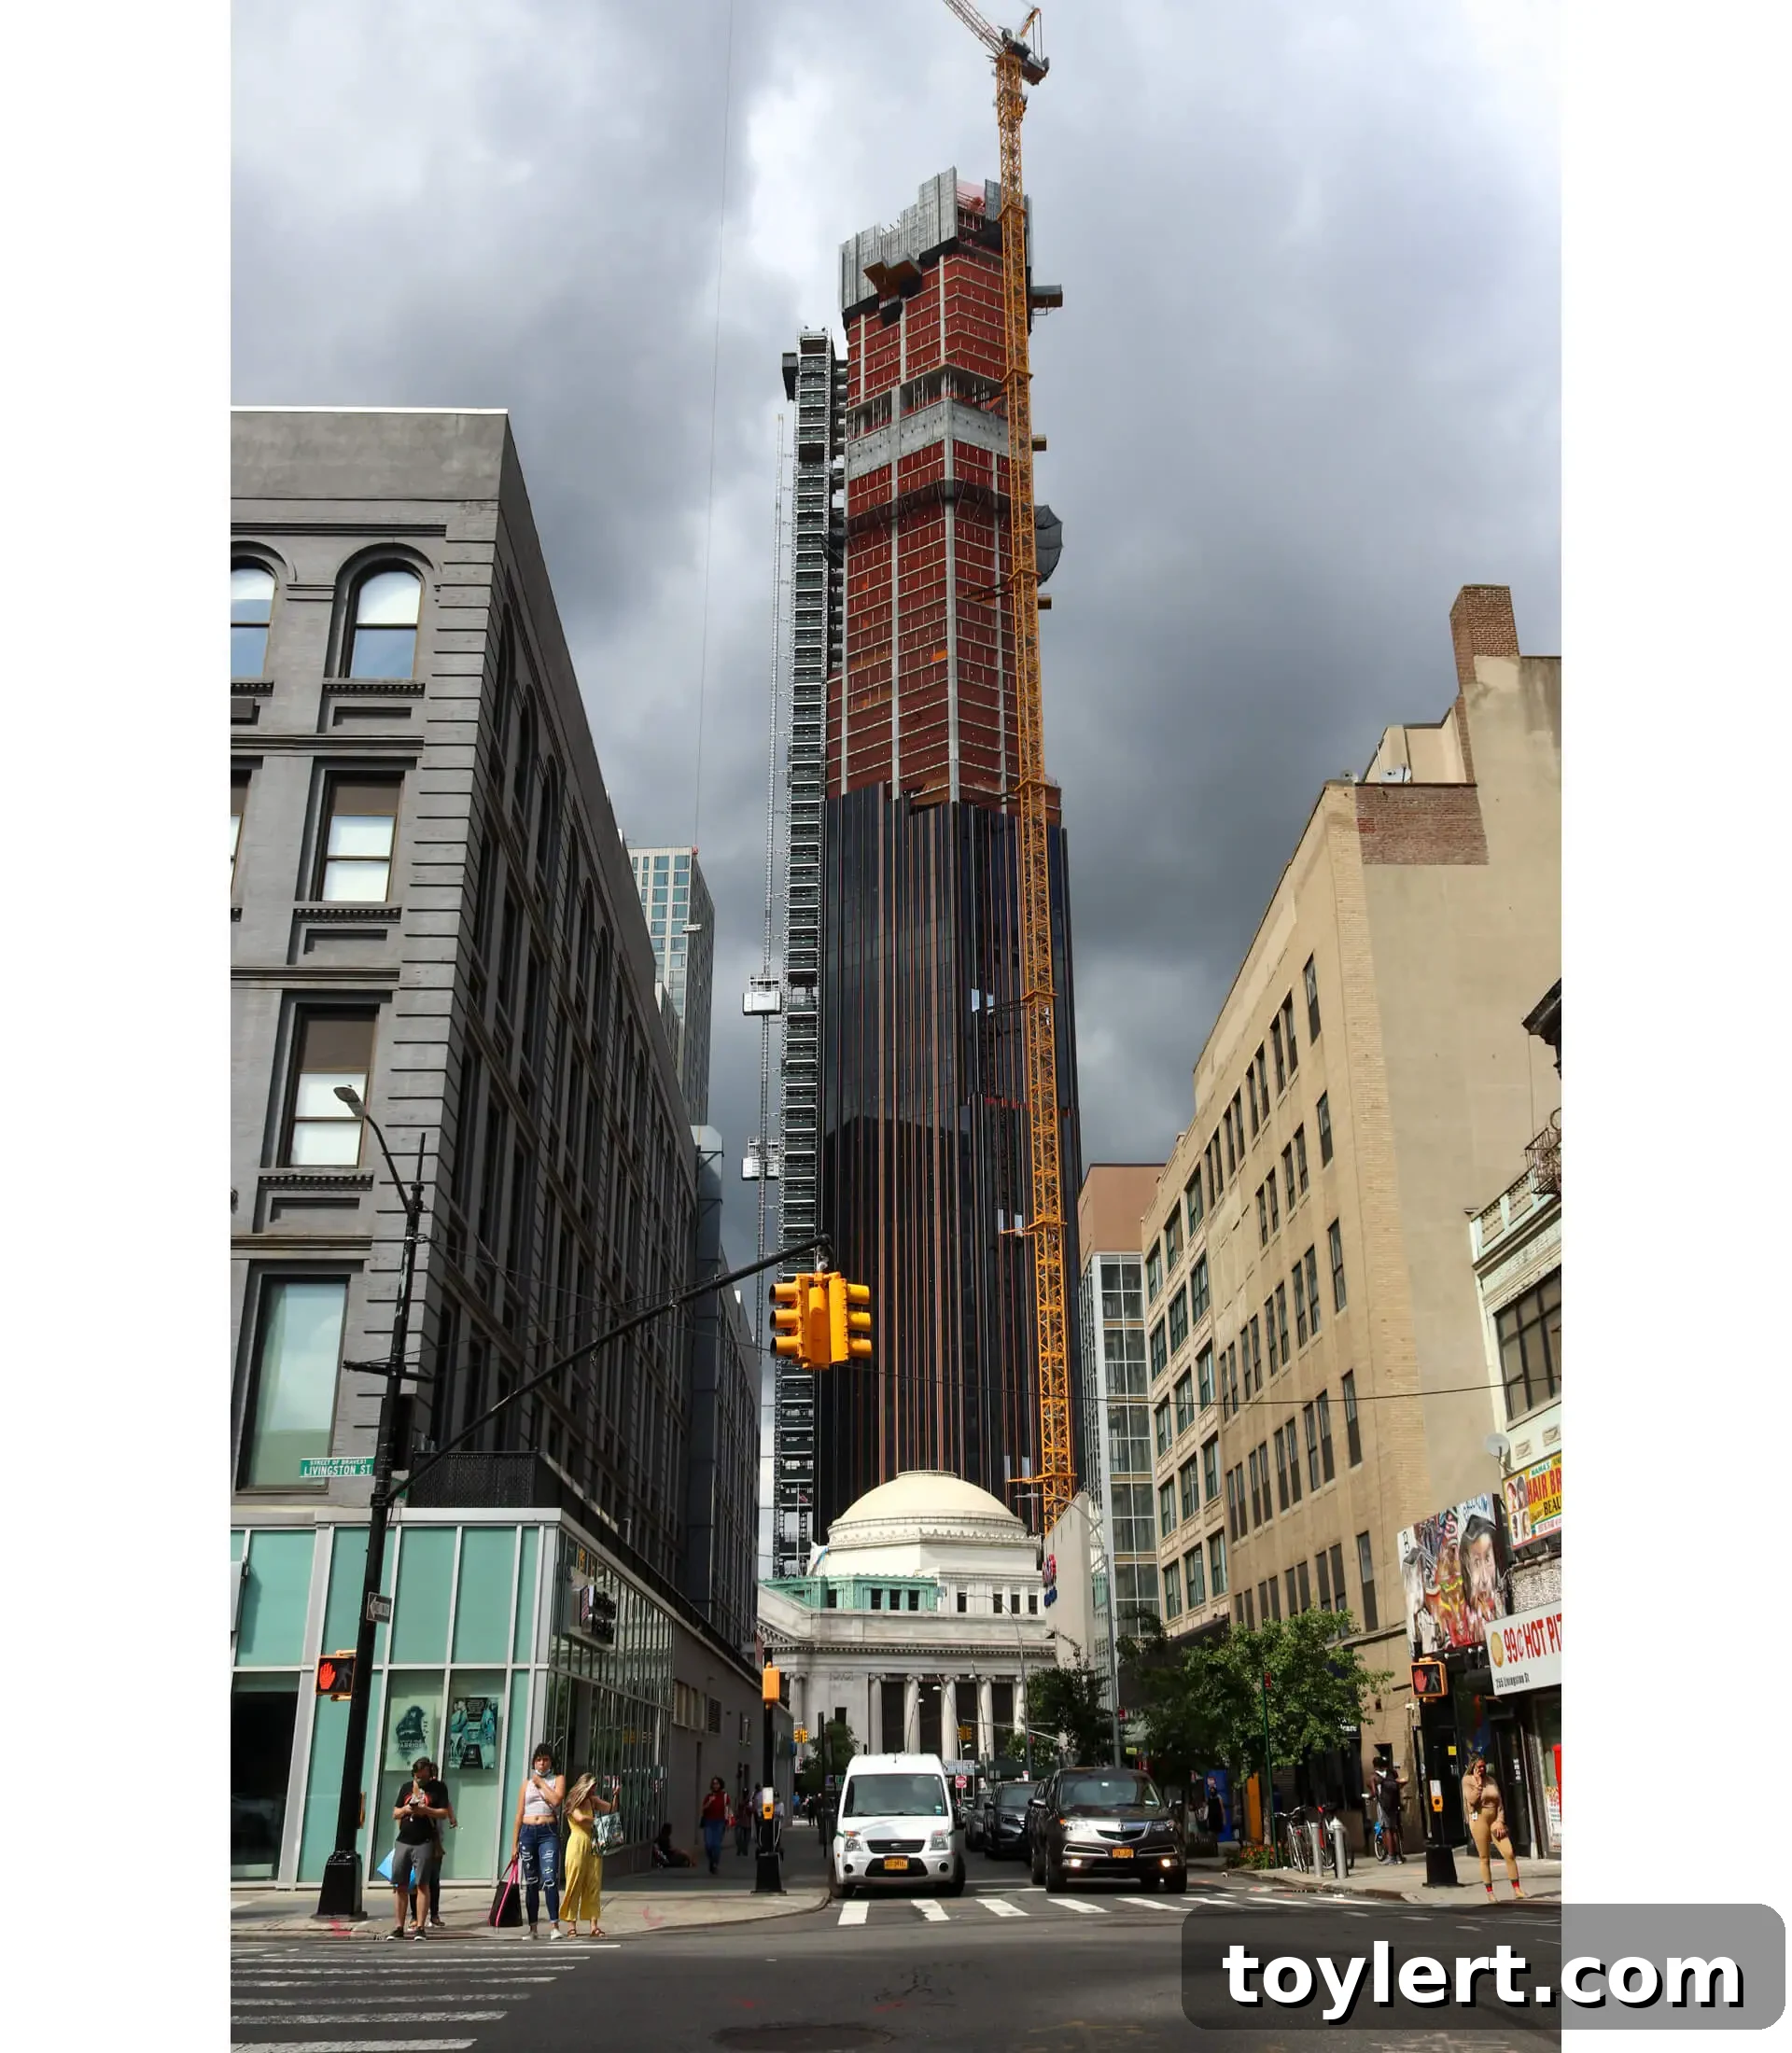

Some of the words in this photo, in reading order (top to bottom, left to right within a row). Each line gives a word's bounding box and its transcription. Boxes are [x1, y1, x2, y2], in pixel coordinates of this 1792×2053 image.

[304, 1465, 355, 1474] LIVINGSTON
[360, 1465, 371, 1474] ST
[1526, 1473, 1548, 1505] HAIR
[1504, 1622, 1524, 1664] 99¢
[1522, 1618, 1547, 1659] HOT
